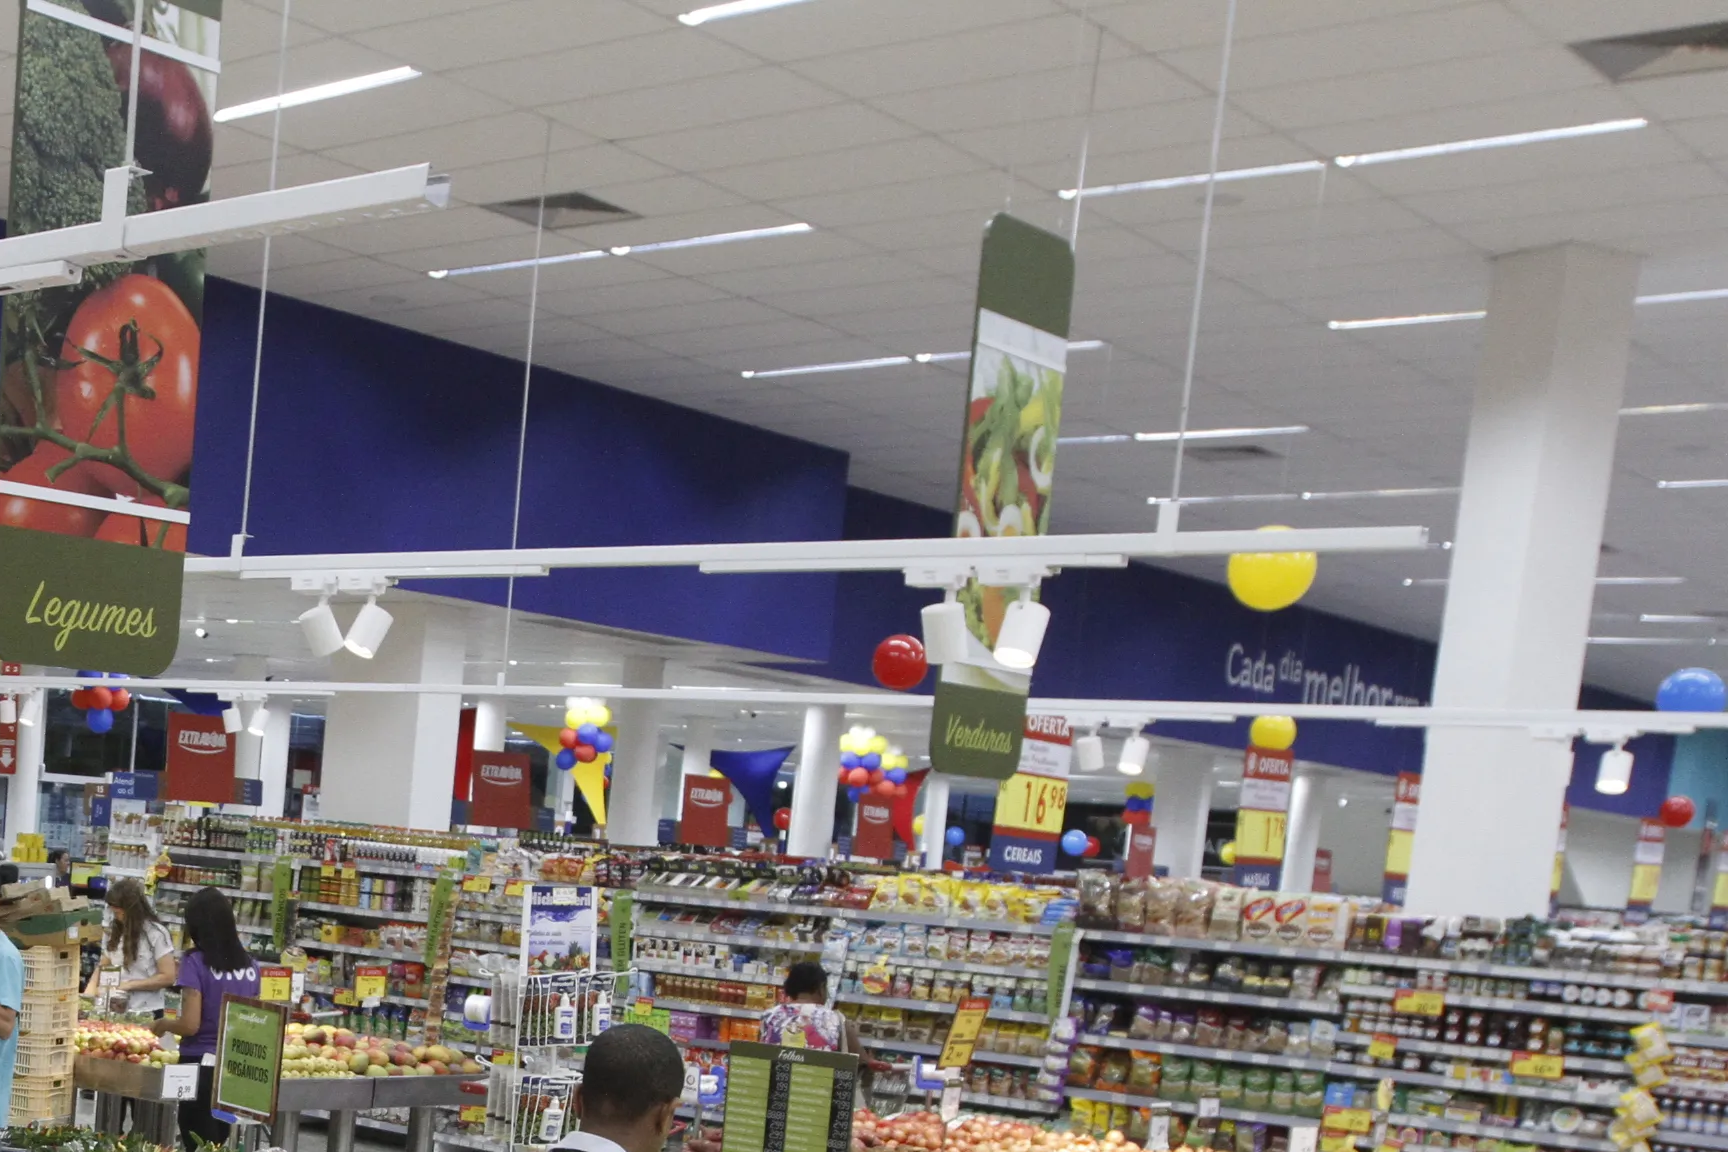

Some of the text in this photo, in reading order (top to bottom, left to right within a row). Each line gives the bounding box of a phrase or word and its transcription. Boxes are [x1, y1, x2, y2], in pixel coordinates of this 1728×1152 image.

[25, 580, 157, 652] Legumes
[1226, 642, 1393, 706] Cada dia melhor
[945, 713, 1012, 754] Verduras
[1027, 714, 1071, 738] OFERTA
[178, 730, 227, 748] EXTRABOM
[1259, 757, 1289, 774] OFERTA
[1003, 846, 1043, 865] CEREAIS
[232, 1038, 268, 1061] PRODUTOS
[778, 1049, 805, 1063] Folhas
[227, 1059, 269, 1084] ORGÂNICOS
